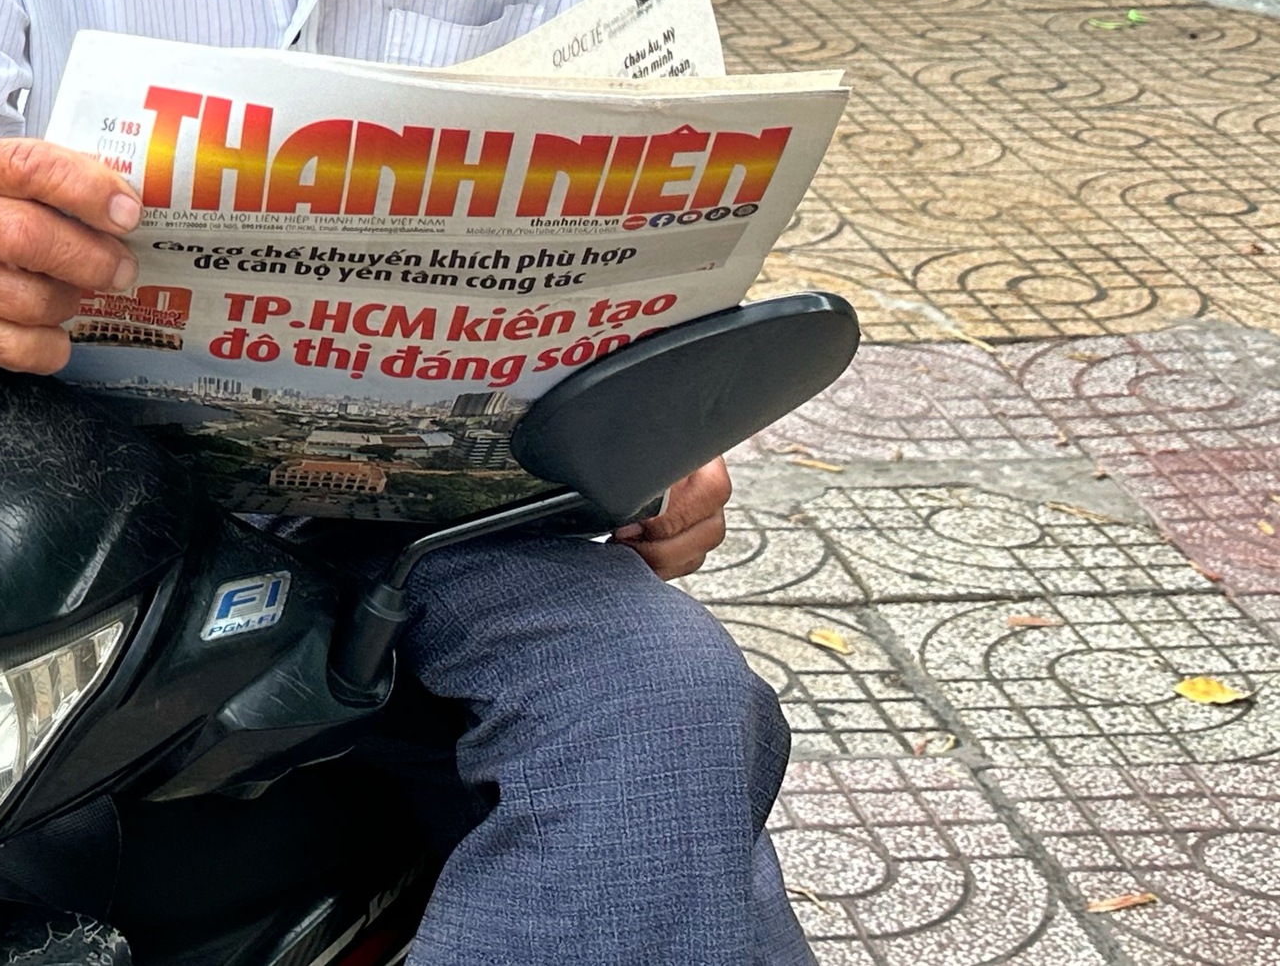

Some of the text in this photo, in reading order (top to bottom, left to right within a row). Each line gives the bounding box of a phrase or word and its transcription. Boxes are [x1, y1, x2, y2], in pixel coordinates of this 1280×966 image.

[102, 117, 141, 136] Số 183
[97, 136, 136, 159] (11131)
[144, 85, 793, 218] THANH NIÊN
[314, 216, 353, 225] THANH
[358, 216, 386, 226] NIÊN
[418, 218, 445, 227] NAM
[530, 217, 619, 227] thanhnien.vn
[250, 245, 304, 260] chế
[308, 247, 422, 267] khuyến
[429, 249, 510, 269] khích
[516, 248, 575, 274] phù
[581, 246, 637, 266] hợp
[294, 261, 331, 281] bộ
[465, 270, 537, 294] công
[543, 270, 587, 288] tác
[224, 292, 679, 343] TP.HCM kiến tạo
[209, 327, 668, 388] đô thị đáng sốn
